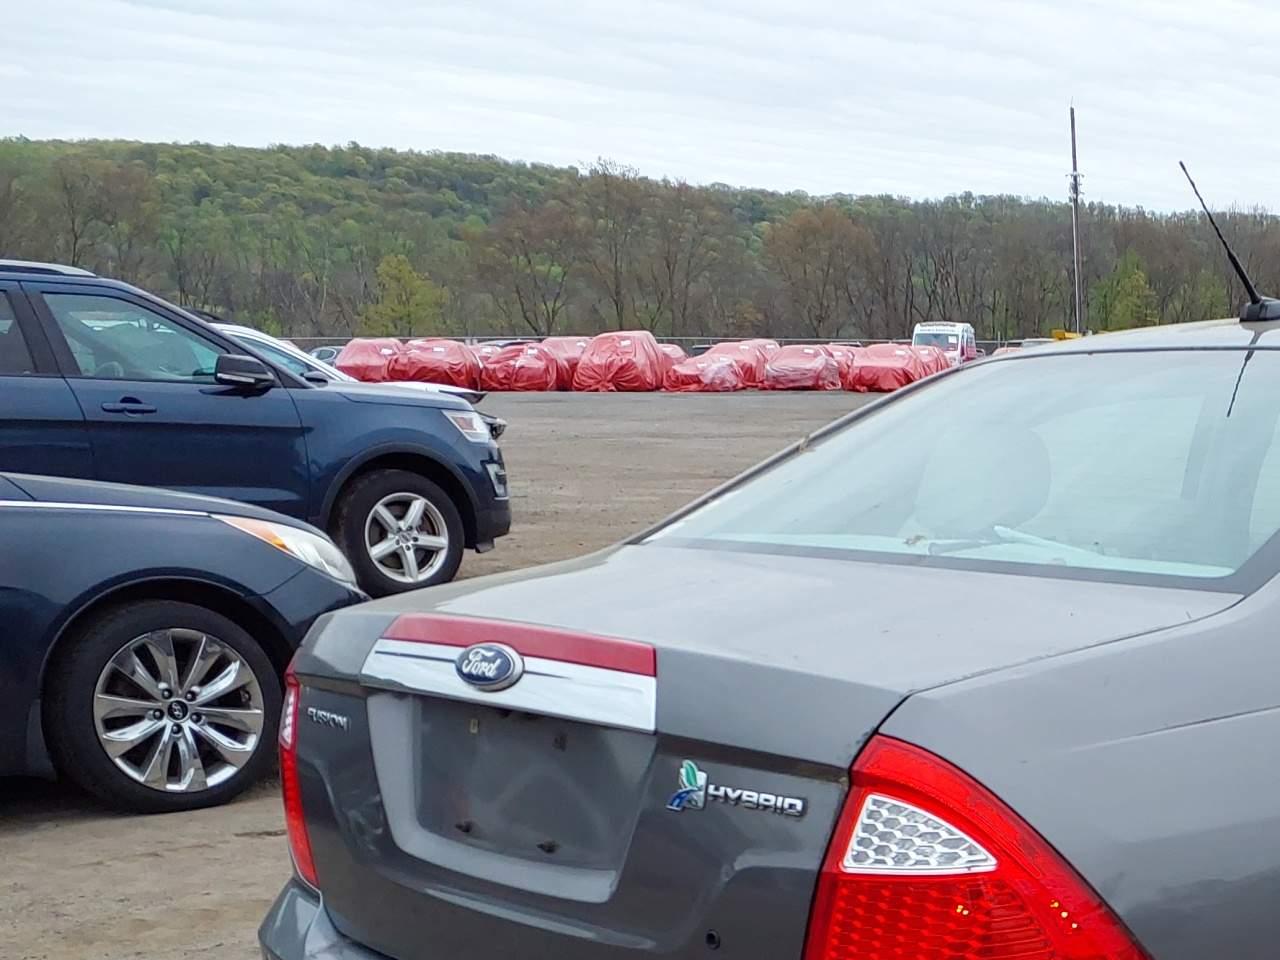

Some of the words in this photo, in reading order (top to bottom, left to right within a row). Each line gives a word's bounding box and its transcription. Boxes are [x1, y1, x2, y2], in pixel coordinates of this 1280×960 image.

[462, 647, 502, 678] Ford
[306, 707, 348, 731] FUSION
[706, 783, 805, 816] HYBRID
